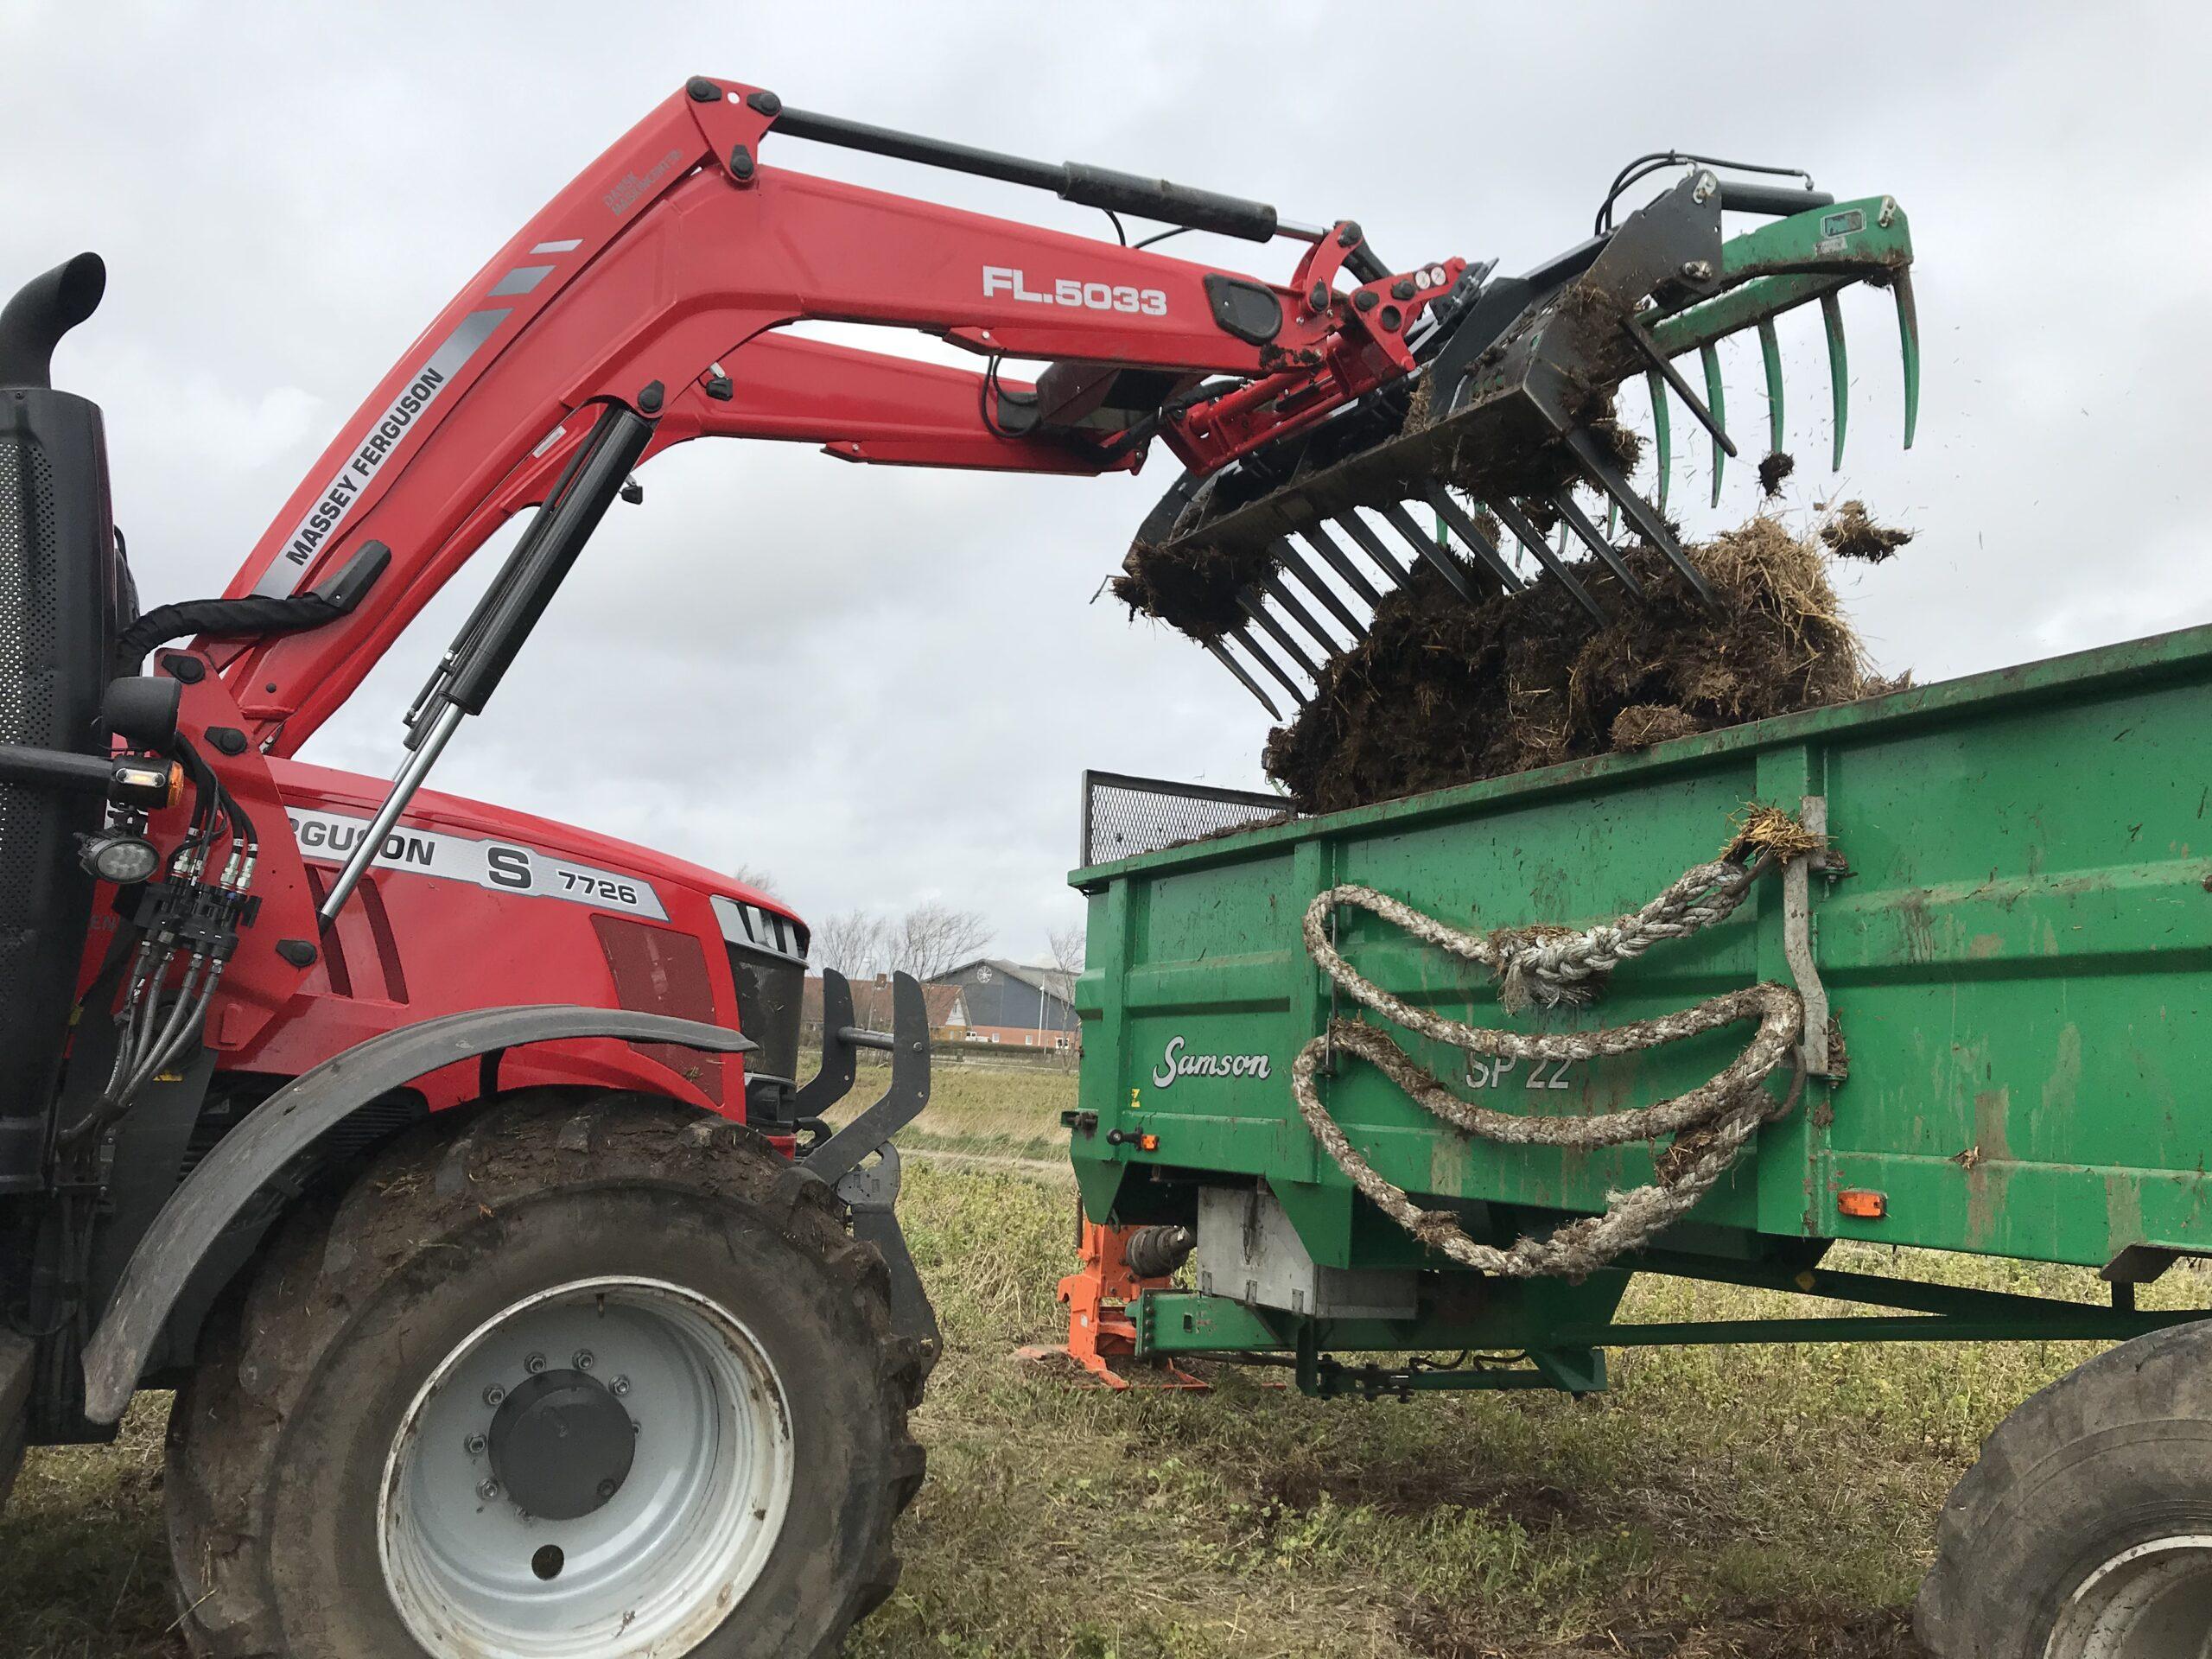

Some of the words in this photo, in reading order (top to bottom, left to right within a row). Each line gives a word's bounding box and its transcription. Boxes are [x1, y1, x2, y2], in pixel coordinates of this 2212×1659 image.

[982, 265, 1167, 315] FL.5033
[285, 474, 358, 567] MASSEY
[351, 367, 445, 477] FERGUSON
[487, 846, 532, 890] S
[556, 870, 638, 906] 7726
[1152, 1035, 1272, 1089] Samson
[1465, 1050, 1517, 1089] SP
[1525, 1057, 1574, 1090] 22
